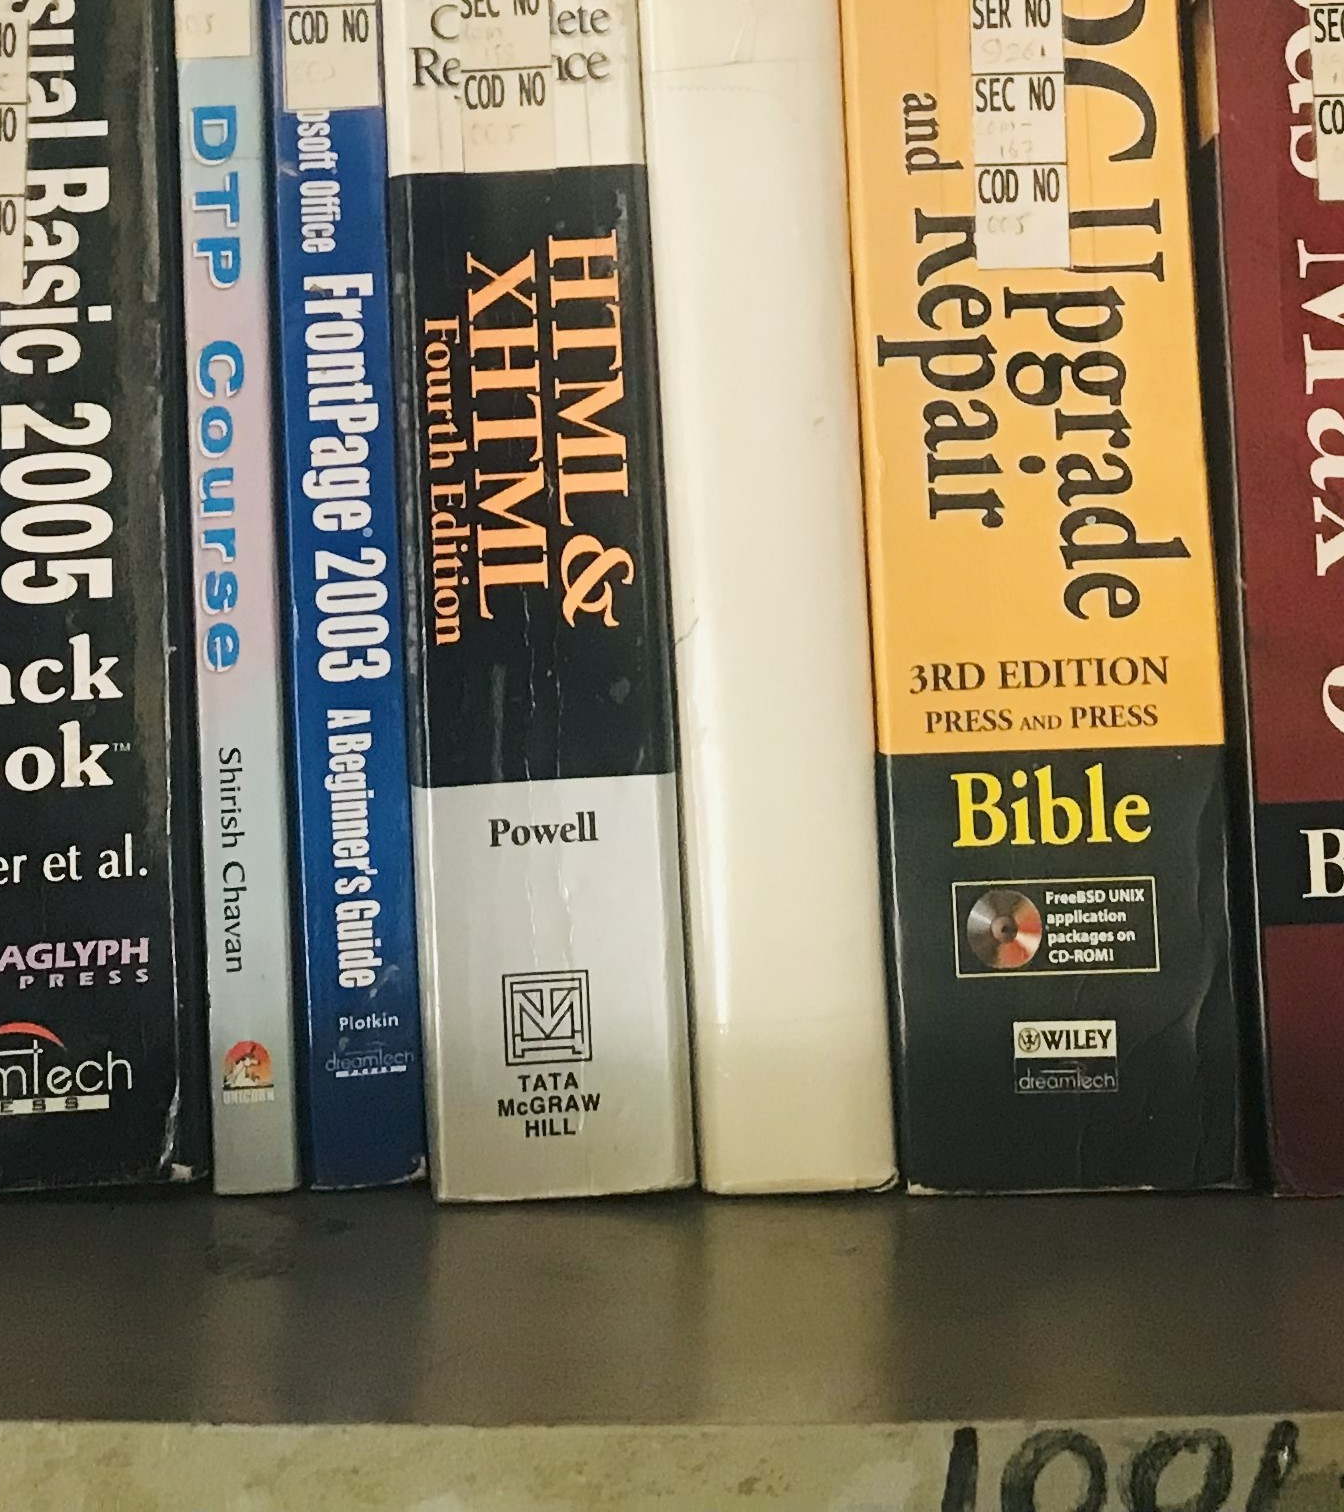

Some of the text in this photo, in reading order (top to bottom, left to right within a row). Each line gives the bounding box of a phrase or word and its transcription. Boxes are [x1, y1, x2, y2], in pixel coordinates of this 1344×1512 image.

[464, 73, 545, 109] COD NO
[301, 177, 336, 254] Office
[875, 92, 1046, 528] and Repair
[188, 104, 246, 673] DTP Course
[303, 272, 376, 532] FrontPage
[466, 250, 549, 621] XHTML
[547, 228, 635, 629] HTML &
[423, 315, 470, 646] Fourth Edition
[0, 402, 114, 605] 2005
[314, 548, 391, 682] 2003
[909, 656, 1170, 696] 3RD EDITION
[327, 708, 370, 729] A
[925, 706, 1158, 733] PRESS AND PRESS
[951, 763, 1152, 848] Bible
[488, 812, 598, 848] Powell
[44, 849, 82, 883] et
[98, 833, 148, 879] al.
[217, 746, 246, 973] Shirish Chavan
[1045, 887, 1145, 906] FreeBSD UNIX
[1046, 908, 1127, 928] application
[337, 900, 382, 989] Guide
[1047, 929, 1135, 949] packages on
[1048, 948, 1115, 964] CD-ROM!
[20, 967, 149, 989] PRESS
[338, 1012, 398, 1032] Plotkin
[1041, 1028, 1112, 1050] WILEY
[517, 1073, 578, 1093] TATA
[497, 1094, 601, 1117] McGRAW
[525, 1118, 576, 1138] HILL
